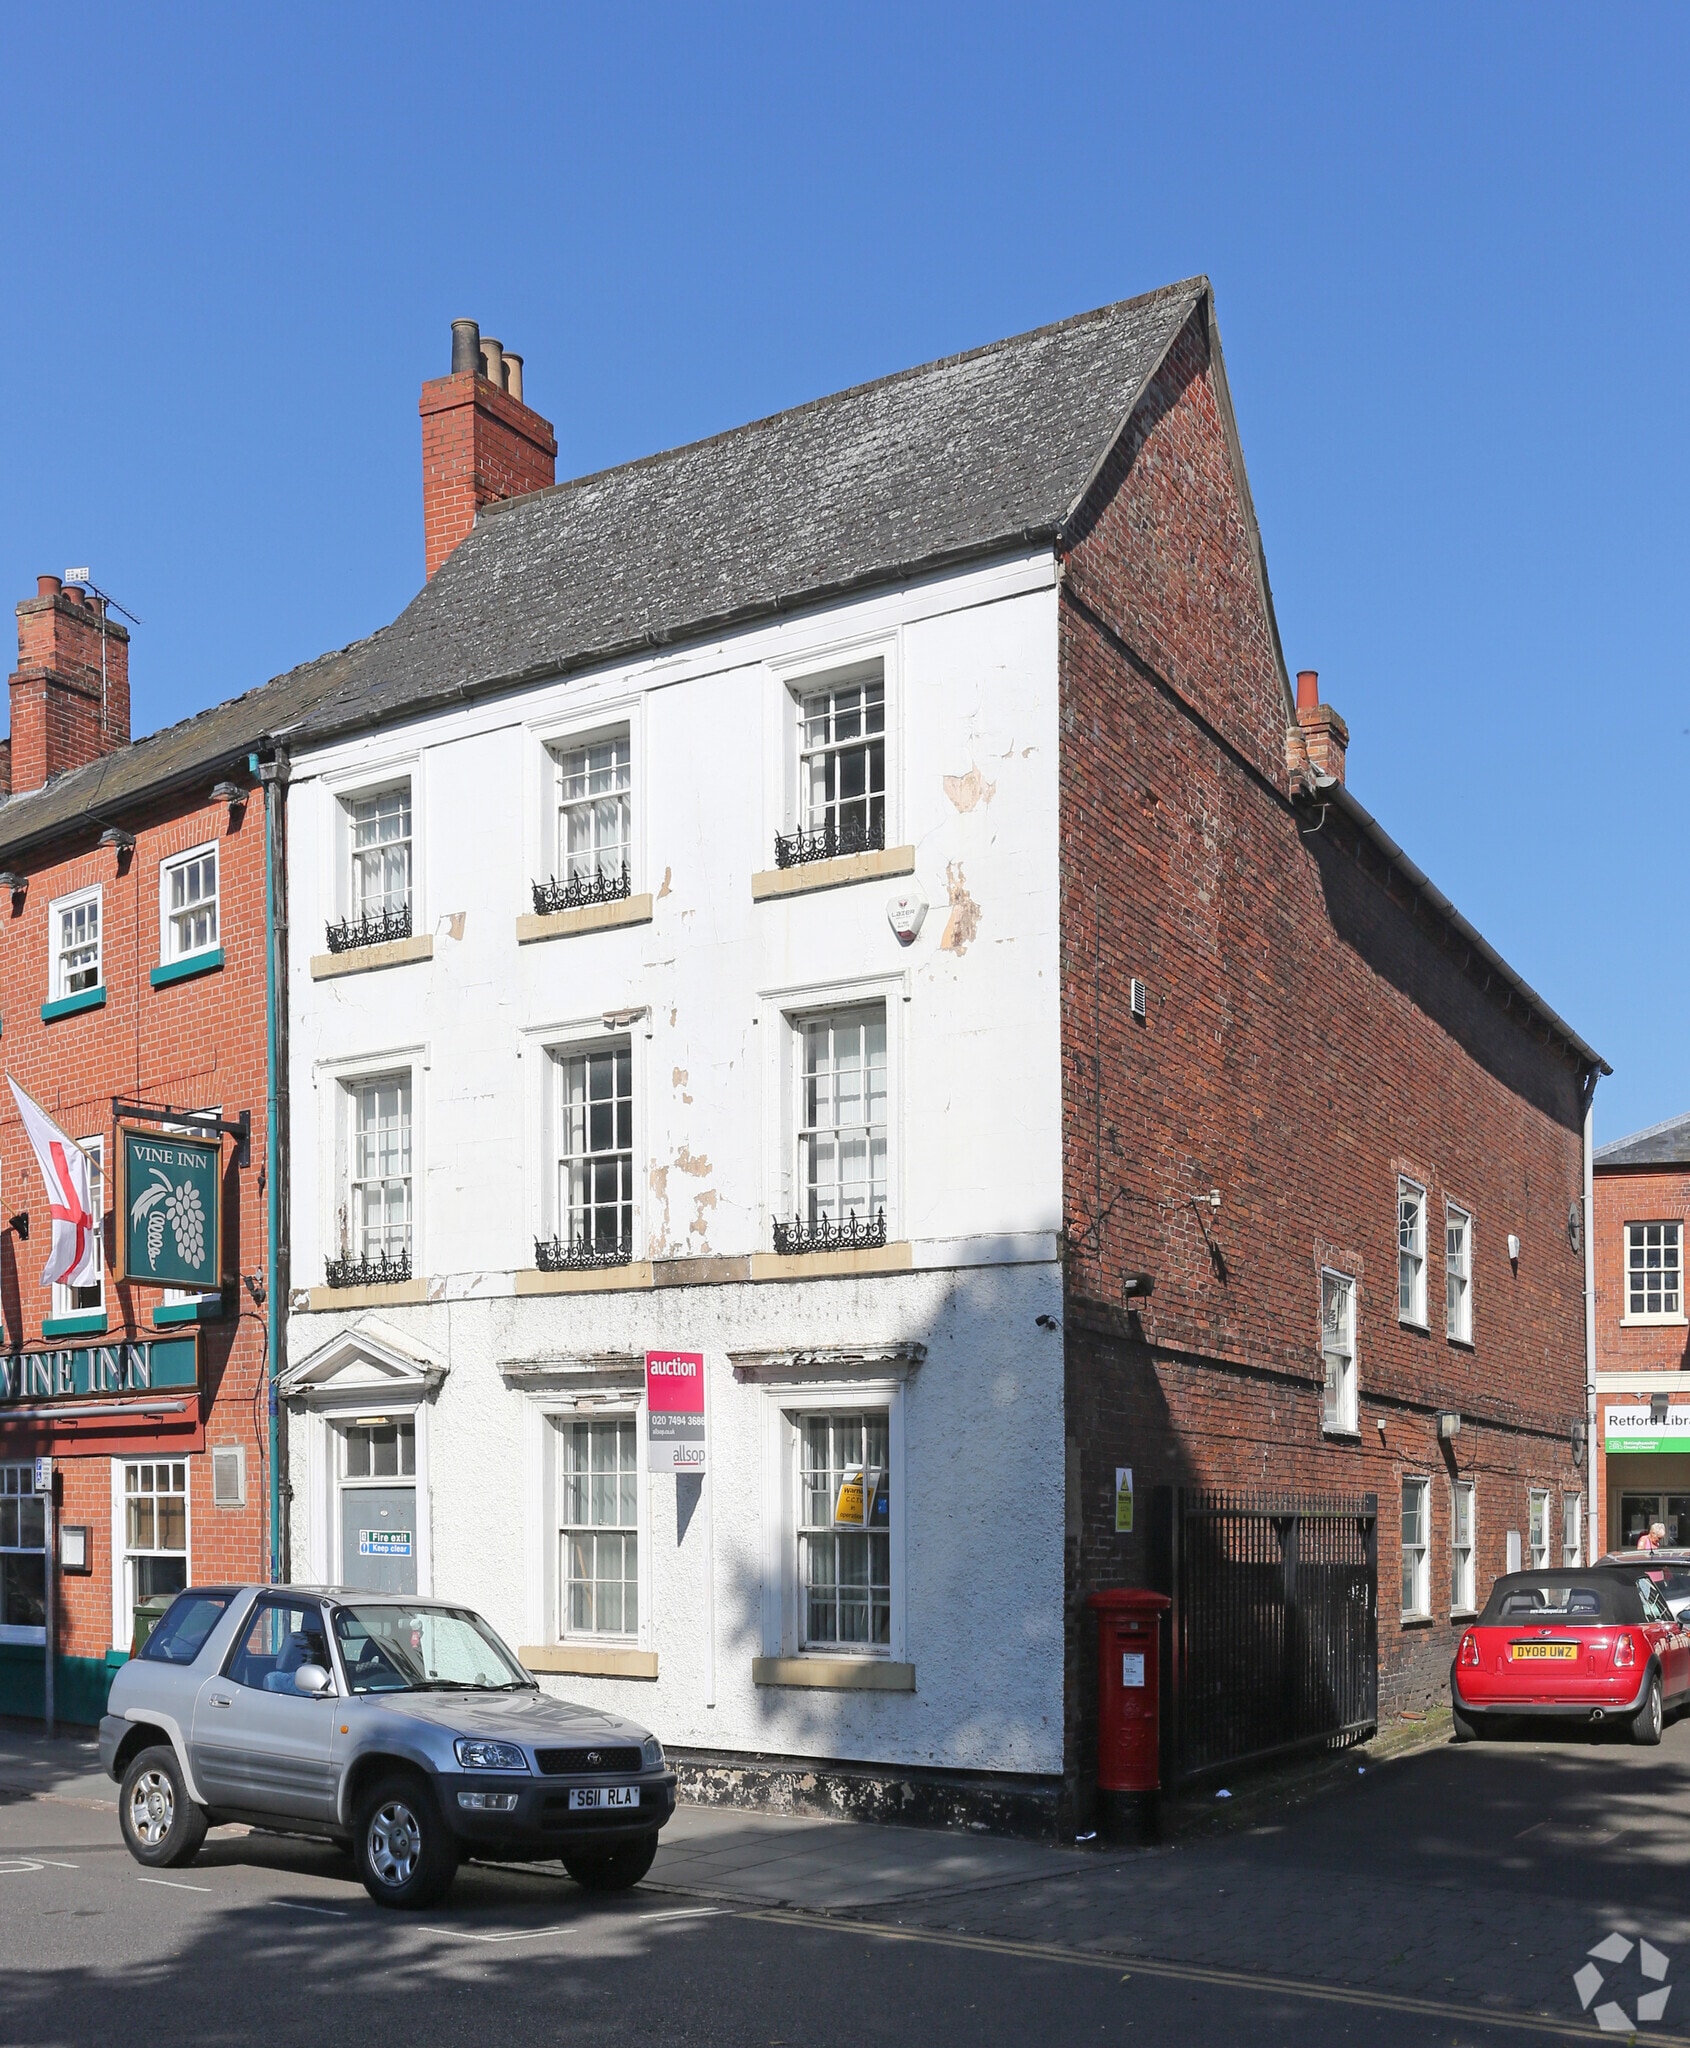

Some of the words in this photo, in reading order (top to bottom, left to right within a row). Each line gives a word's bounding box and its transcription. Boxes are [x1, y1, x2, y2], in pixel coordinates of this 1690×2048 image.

[133, 1145, 174, 1165] VINE
[177, 1151, 208, 1169] INN
[0, 1349, 75, 1398] VINE
[86, 1341, 152, 1393] INN
[650, 1357, 697, 1376] auction
[651, 1415, 667, 1425] 020
[668, 1415, 686, 1426] 7494
[1609, 1415, 1657, 1426] Retford
[1662, 1415, 1690, 1426] Libr
[672, 1444, 706, 1466] allsop
[372, 1532, 389, 1542] Fire
[390, 1533, 407, 1542] exit
[372, 1544, 389, 1554] Keep
[390, 1545, 408, 1553] clear
[1517, 1646, 1547, 1658] DY08
[1550, 1646, 1572, 1658] UWZ
[607, 1788, 632, 1805] RLA
